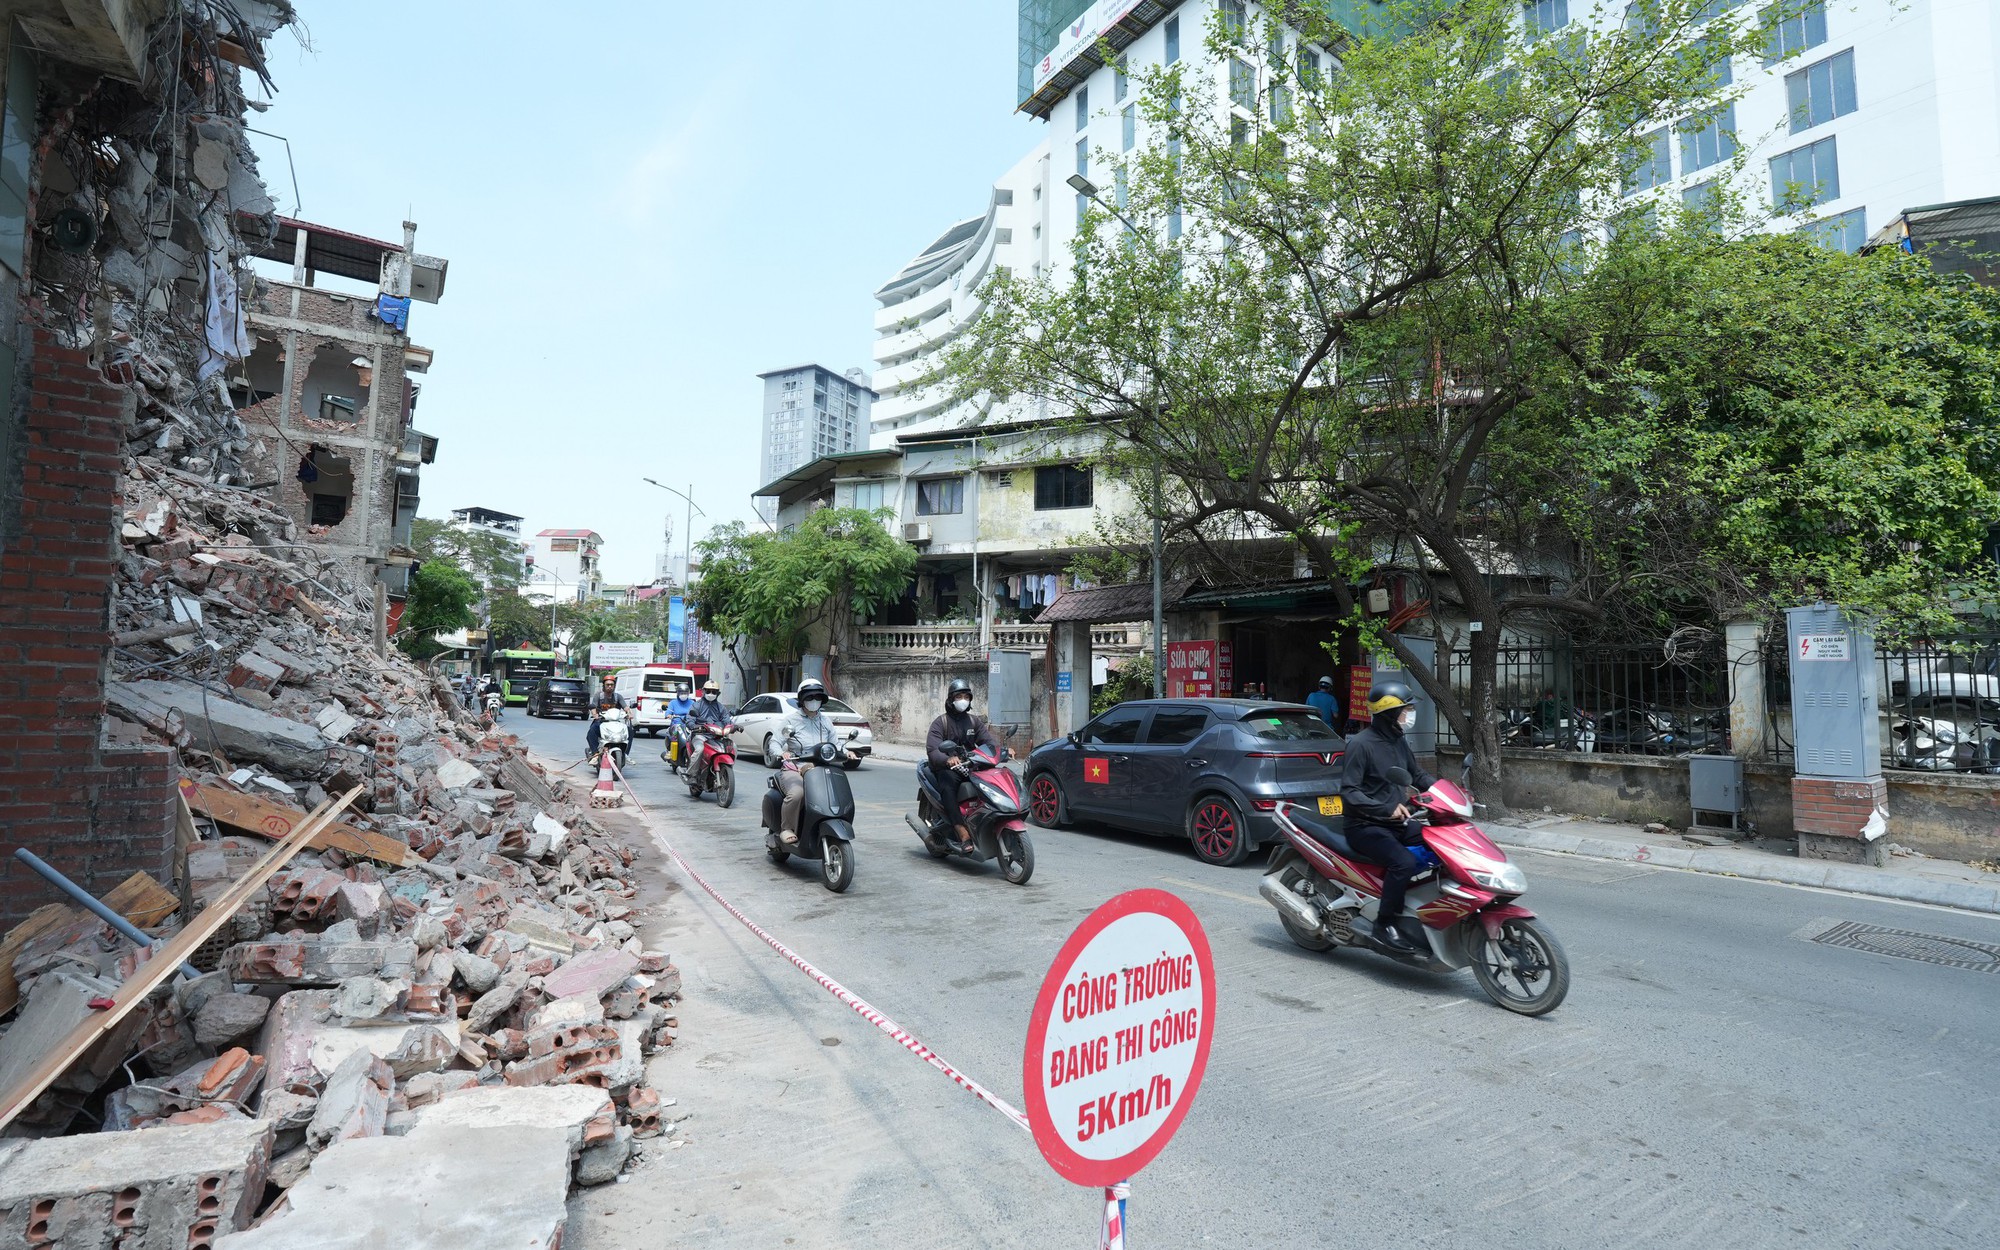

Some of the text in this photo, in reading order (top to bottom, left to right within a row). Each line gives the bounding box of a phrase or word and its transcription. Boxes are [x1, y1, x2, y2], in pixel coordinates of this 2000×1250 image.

[1059, 28, 1097, 63] VITECCONS
[1170, 645, 1211, 669] SỬA CHỮA
[1219, 669, 1225, 678] XE
[1185, 682, 1195, 693] XÔI
[1219, 682, 1225, 690] XE
[1447, 896, 1472, 908] HONDA
[1062, 951, 1193, 1024] CÔNG TRƯỜNG
[1050, 1008, 1198, 1089] ĐANG THI CÔNG
[1076, 1073, 1172, 1143] 5Km/h
